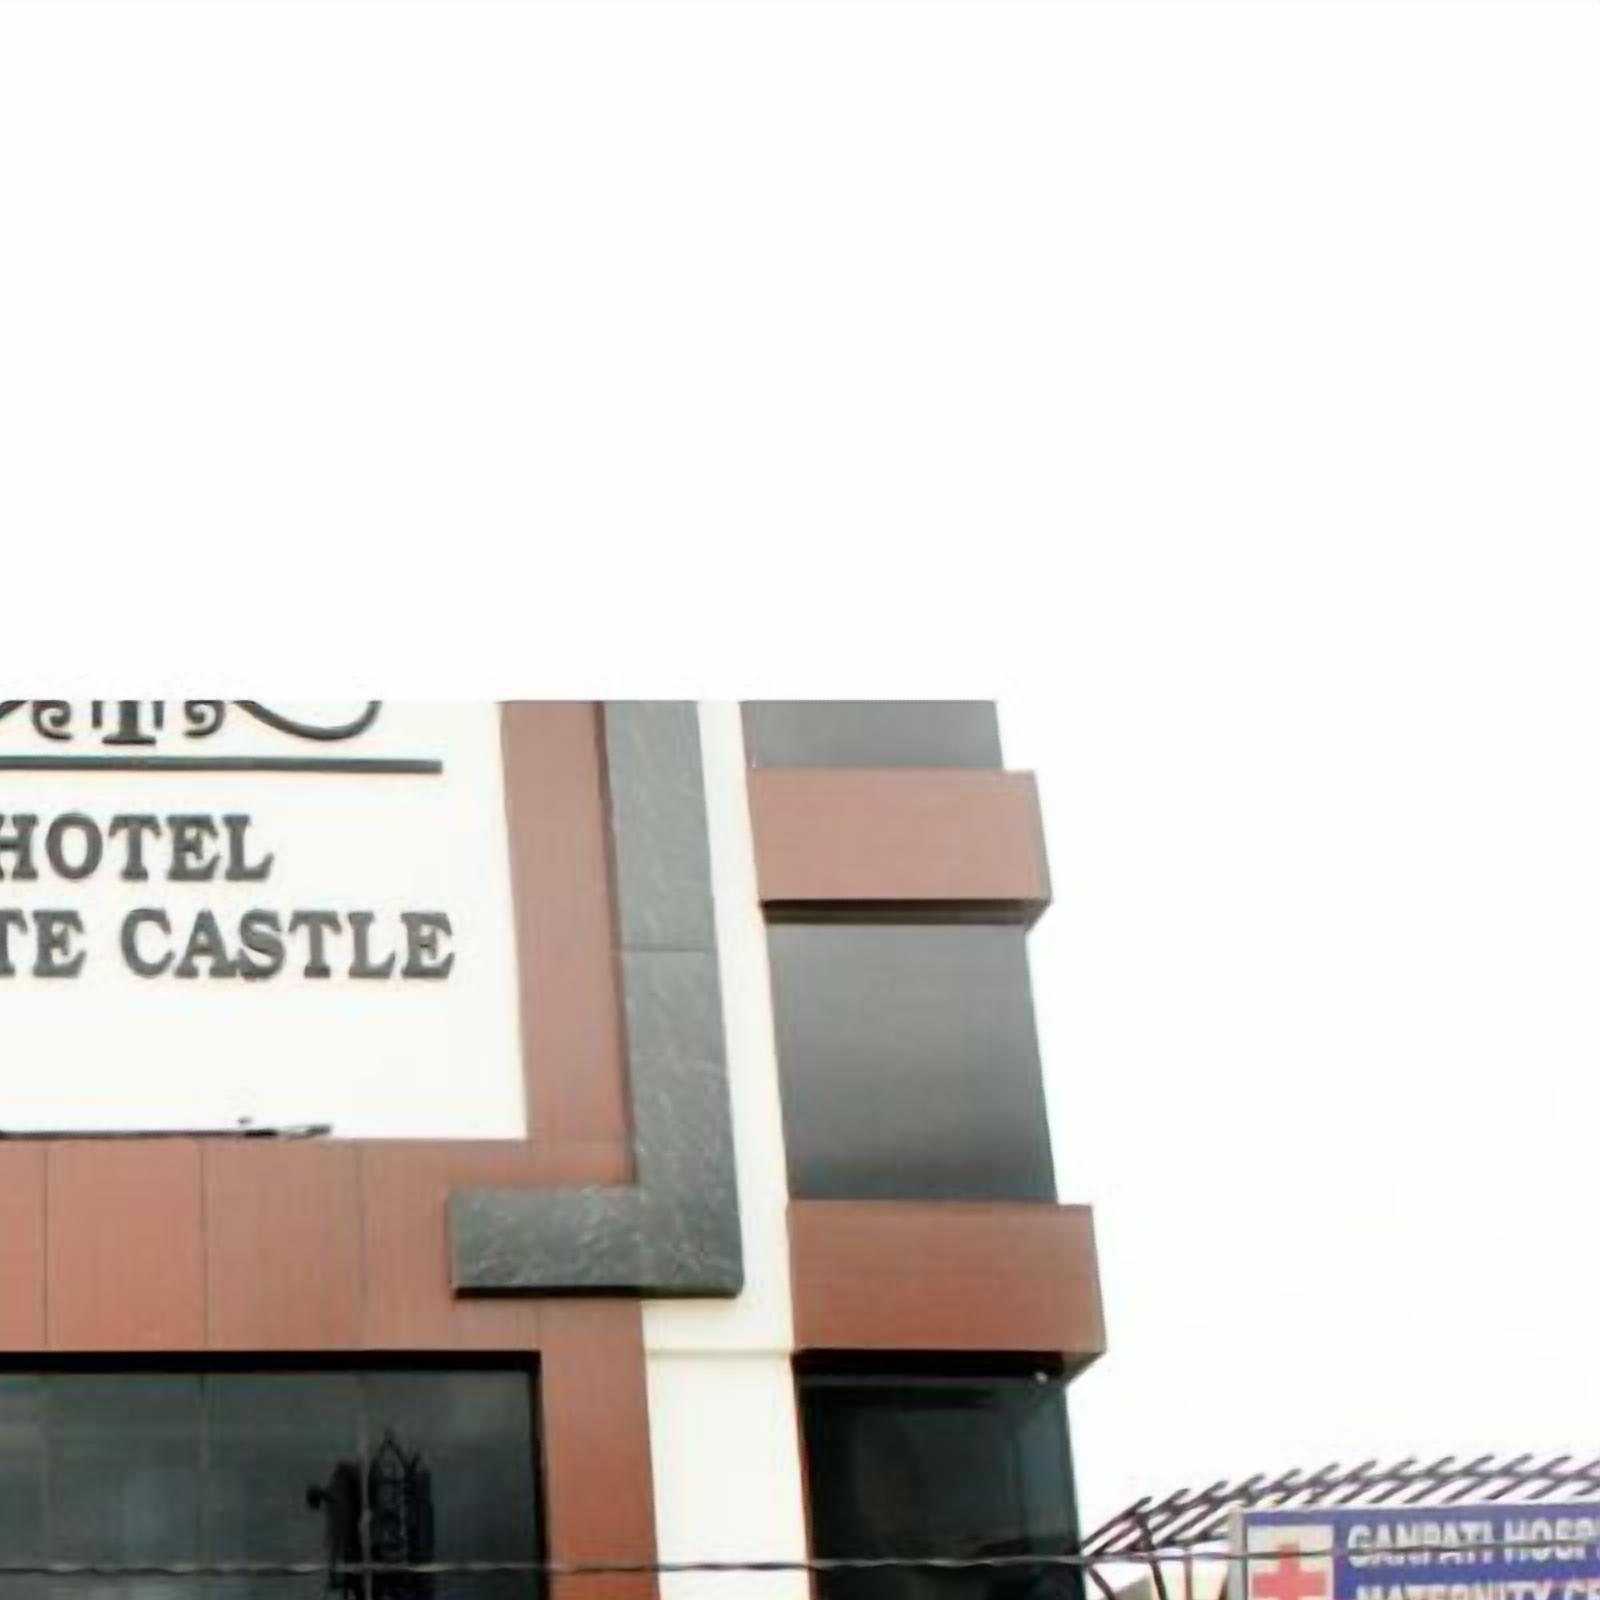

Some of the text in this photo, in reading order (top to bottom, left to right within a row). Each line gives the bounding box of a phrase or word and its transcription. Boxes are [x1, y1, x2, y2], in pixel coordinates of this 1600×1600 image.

[119, 906, 456, 981] CASTLE
[1346, 1516, 1600, 1568] GANPATI HOSP
